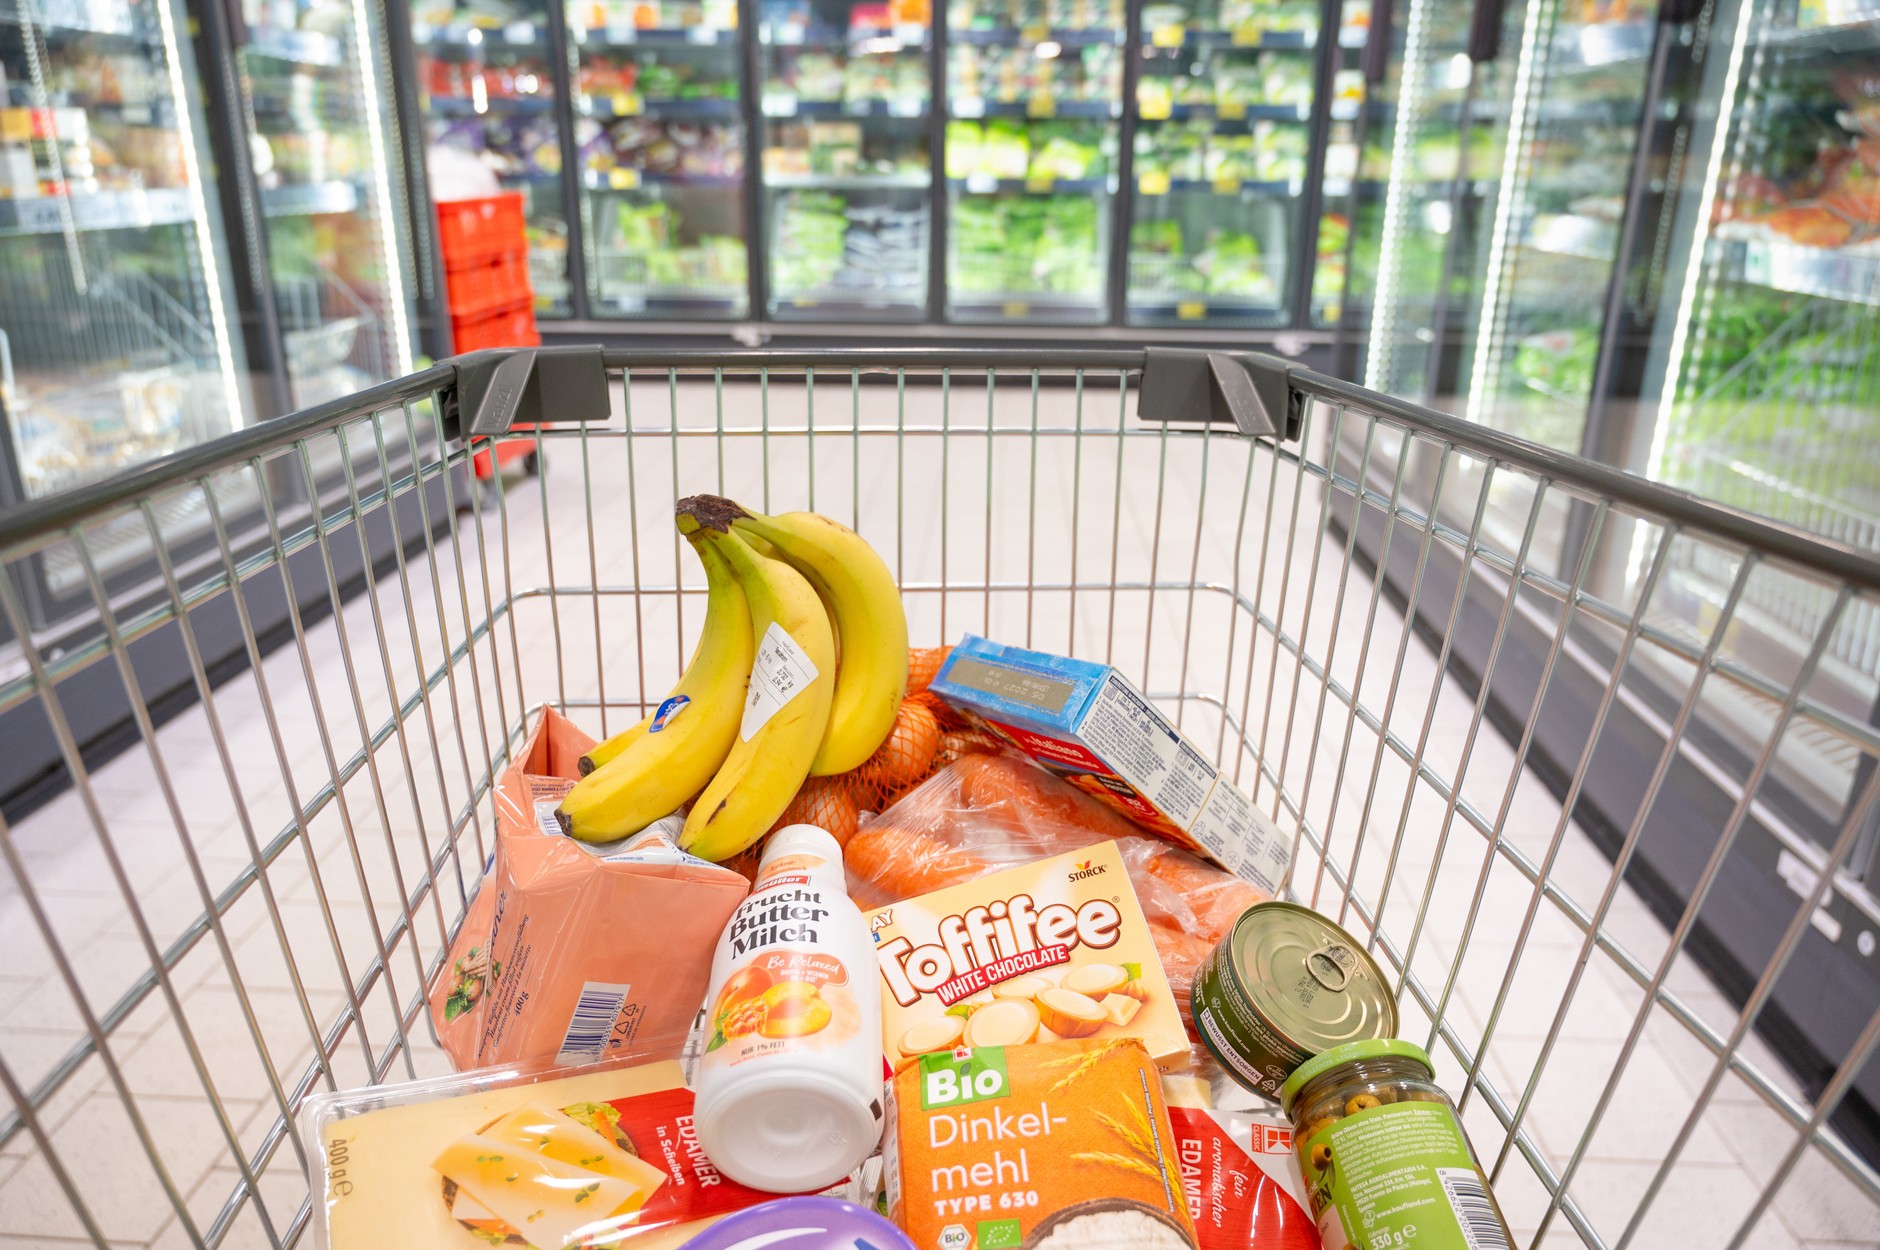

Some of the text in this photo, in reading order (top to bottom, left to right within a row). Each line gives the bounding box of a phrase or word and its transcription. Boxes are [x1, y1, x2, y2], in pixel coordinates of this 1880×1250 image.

[1068, 864, 1107, 883] STORCK
[735, 889, 823, 921] Frucht
[869, 909, 893, 933] AY
[728, 905, 830, 943] Butter
[731, 922, 819, 960] Milch
[767, 954, 841, 976] Be Relaxed
[877, 894, 1122, 1007] Toffifee
[806, 970, 829, 979] VITAMIN
[937, 946, 1067, 1004] WHITE CHOCOLATE
[511, 989, 529, 1017] 400g
[740, 1039, 785, 1055] NUR 1% FETT
[1216, 1009, 1250, 1054] www.kaufland.com
[1206, 1020, 1260, 1080] BEWUSST ENTSORGEN
[927, 1064, 1003, 1105] Bio
[929, 1101, 1068, 1148] Dinkel-
[1252, 1125, 1262, 1152] CLASSIC
[329, 1139, 349, 1165] 400
[656, 1126, 685, 1186] in Scheiben
[676, 1115, 721, 1187] EDAMER
[329, 1169, 346, 1179] g
[931, 1148, 1031, 1192] mehl
[1181, 1138, 1202, 1220] EDAMER
[1211, 1136, 1227, 1229] aromatischer
[1229, 1168, 1249, 1200] fein
[934, 1190, 1039, 1216] TYPE 630
[1374, 1195, 1436, 1218] www.kaufland.com
[1438, 1168, 1446, 1176] 8
[1442, 1177, 1462, 1214] 426622
[1369, 1232, 1392, 1250] 330
[1393, 1230, 1403, 1245] g
